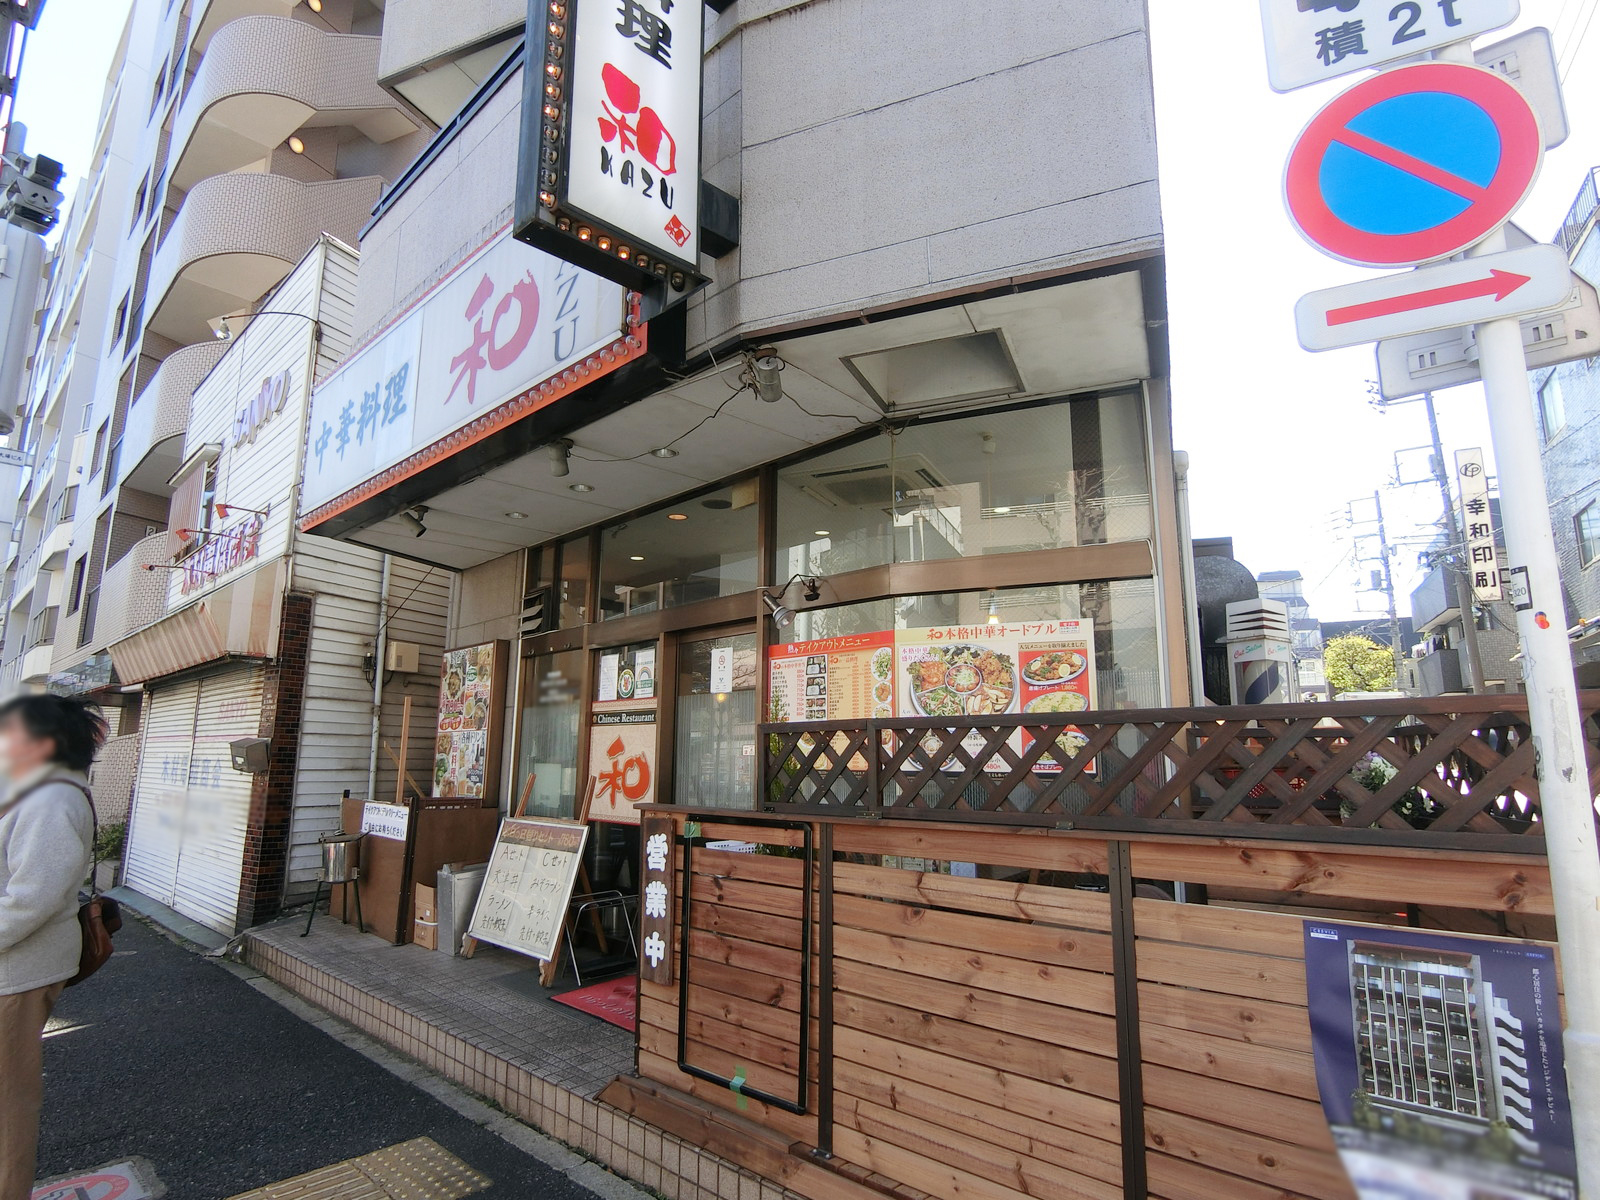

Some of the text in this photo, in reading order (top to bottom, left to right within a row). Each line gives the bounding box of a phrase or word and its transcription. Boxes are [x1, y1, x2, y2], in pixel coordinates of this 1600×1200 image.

[616, 0, 674, 69] 理
[597, 62, 677, 176] 和
[601, 146, 674, 210] KAZU
[444, 268, 540, 405] 和
[553, 258, 580, 362] ZU
[314, 361, 410, 474] 中華料理
[1465, 499, 1497, 588] 幸和印刷
[944, 623, 1058, 641] 本格中華オードブル
[597, 712, 655, 724] Chinese Restaurant
[595, 734, 651, 810] 和
[645, 833, 668, 968] 営業中
